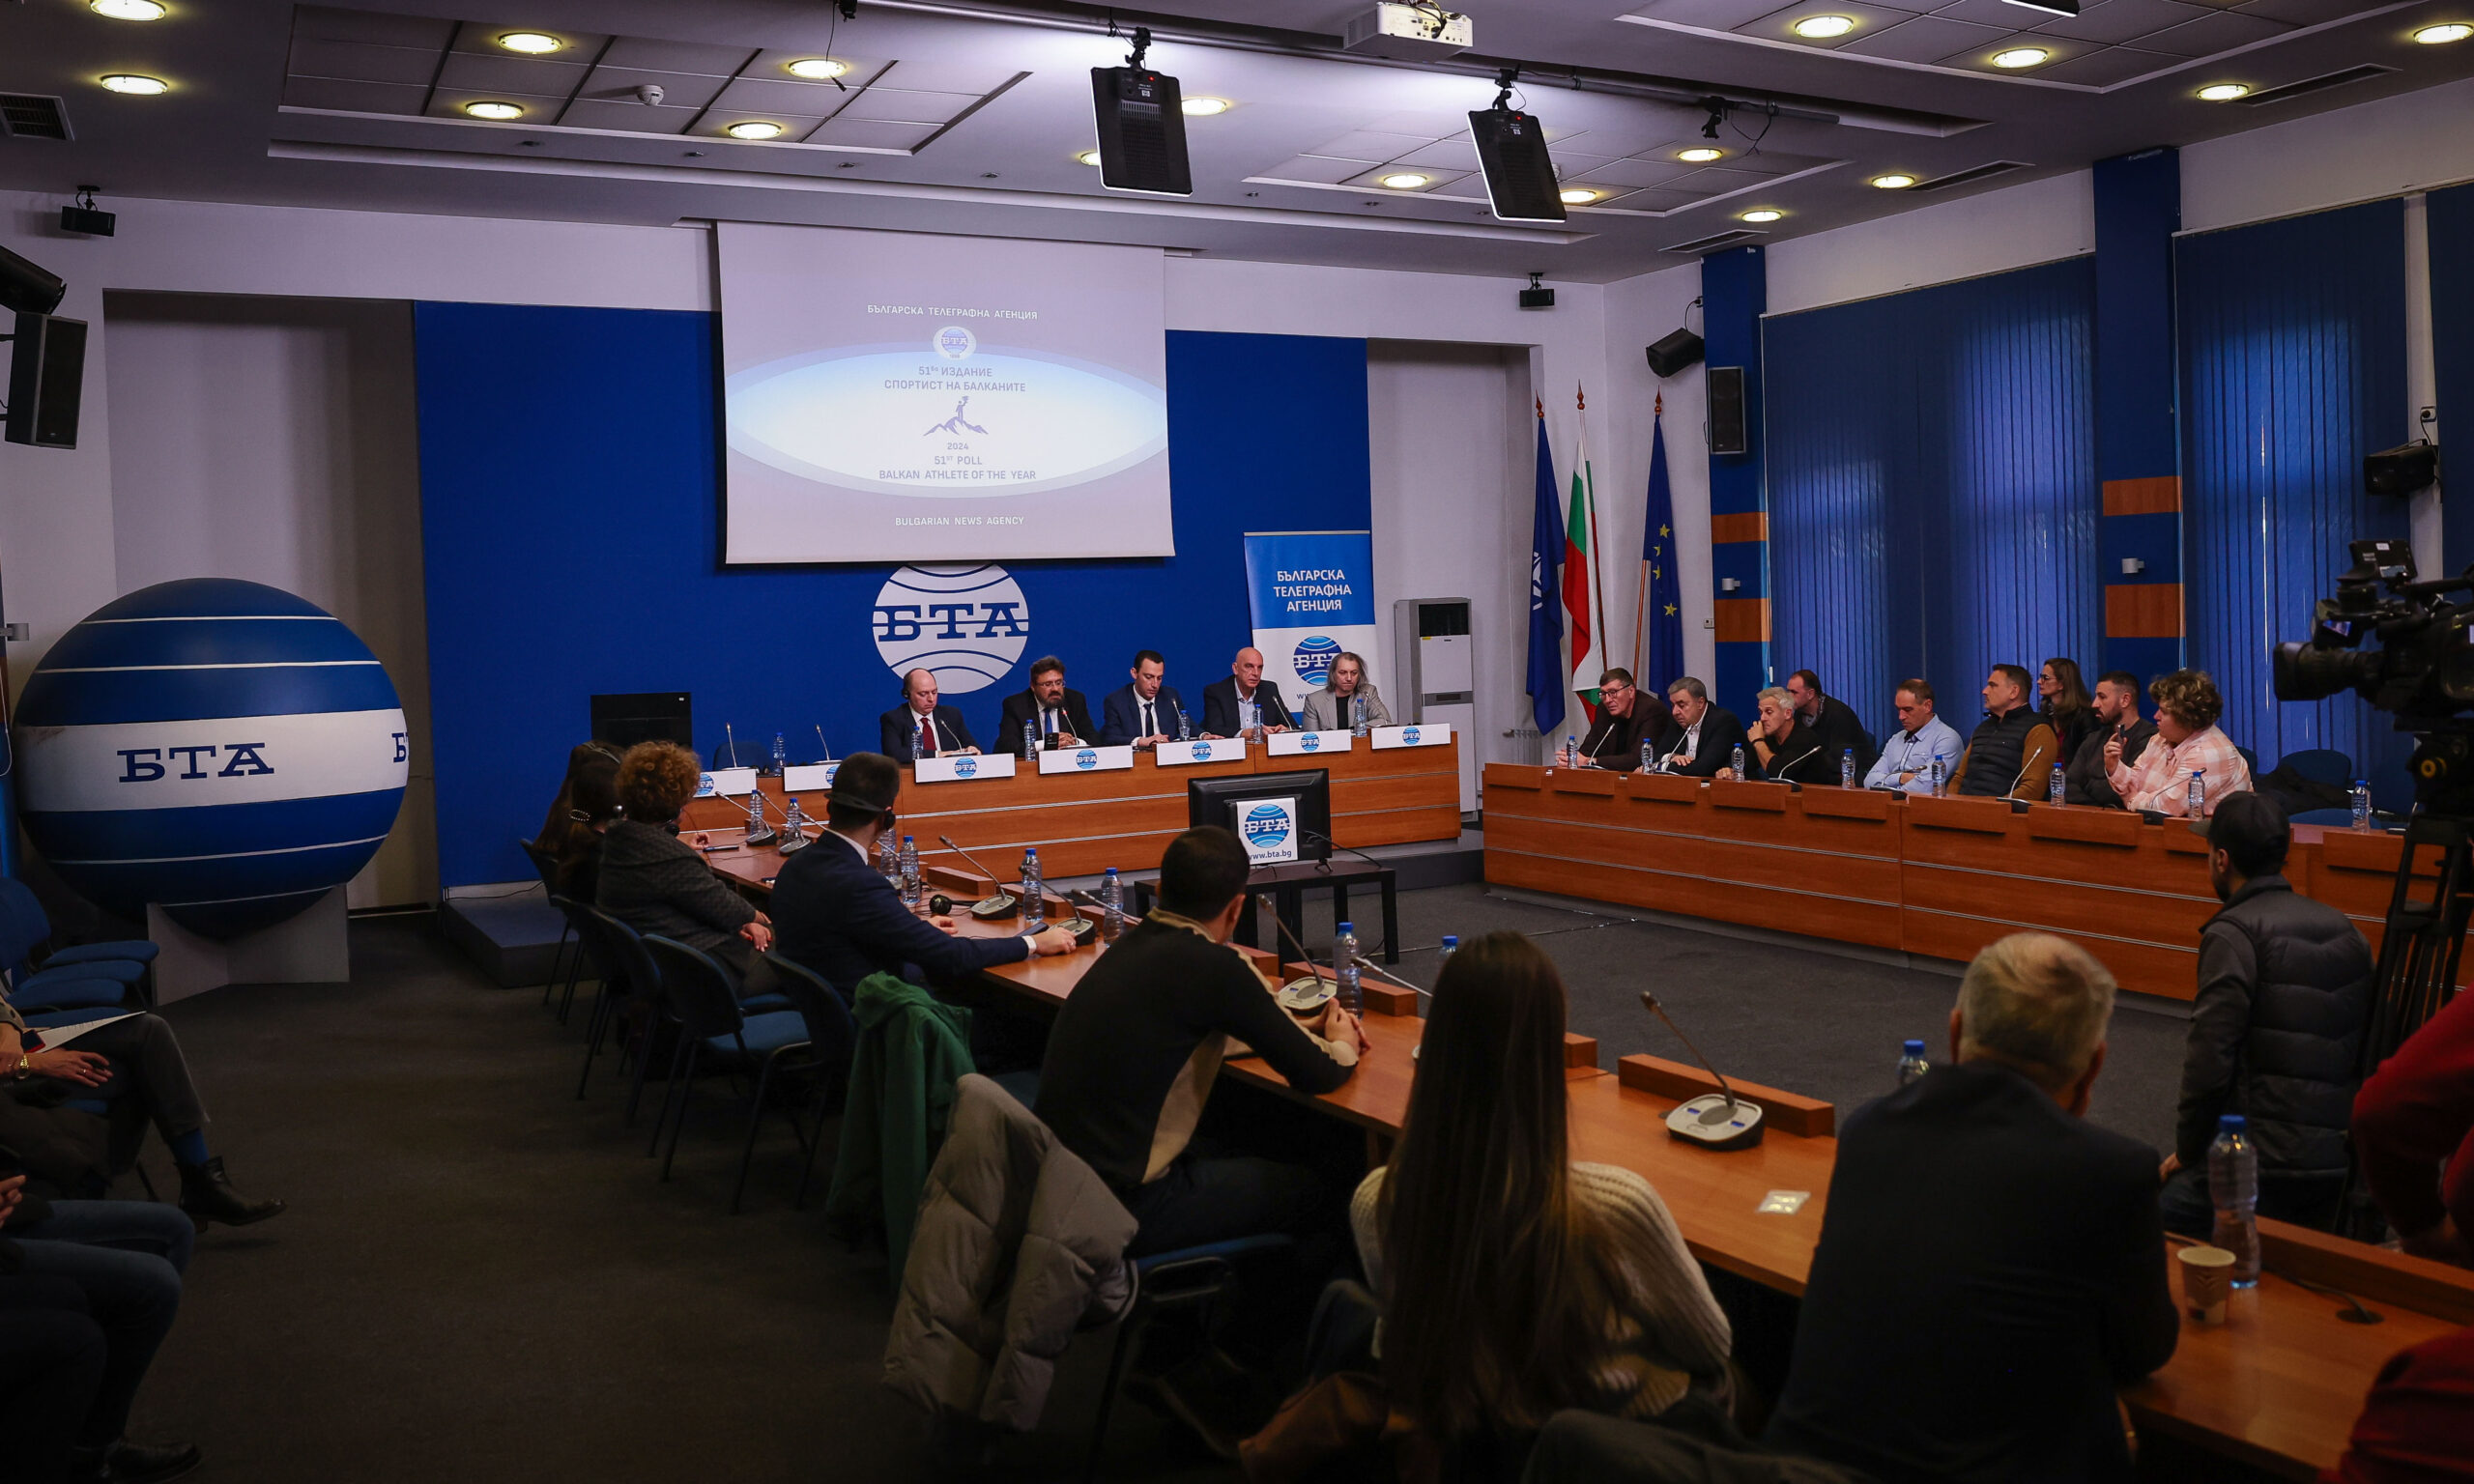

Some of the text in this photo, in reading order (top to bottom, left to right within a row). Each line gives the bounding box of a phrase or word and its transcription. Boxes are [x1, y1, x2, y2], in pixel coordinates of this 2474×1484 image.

[867, 304, 1038, 321] БЪЛГАРСКА ТЕЛЕГРАФНА АГЕНЦИЯ
[941, 366, 992, 378] ИЗДАНИЕ
[884, 379, 1026, 391] СПОРТИСТ НА БАЛКАНИТЕ
[947, 442, 969, 450] 2024
[957, 455, 983, 465] POLL
[878, 470, 1037, 479] BALKAN ATHLETE OF THE YEAR
[895, 516, 1024, 527] BULGARIAN NEWS AGENCY
[1277, 569, 1346, 582] БЪЛГАРСКА
[1273, 584, 1352, 598] ТЕЛЕГРАФНА
[1286, 599, 1342, 613] АГЕНЦИЯ
[873, 602, 1028, 642] БТА
[116, 742, 275, 784] БТА
[1245, 817, 1290, 834] БТА
